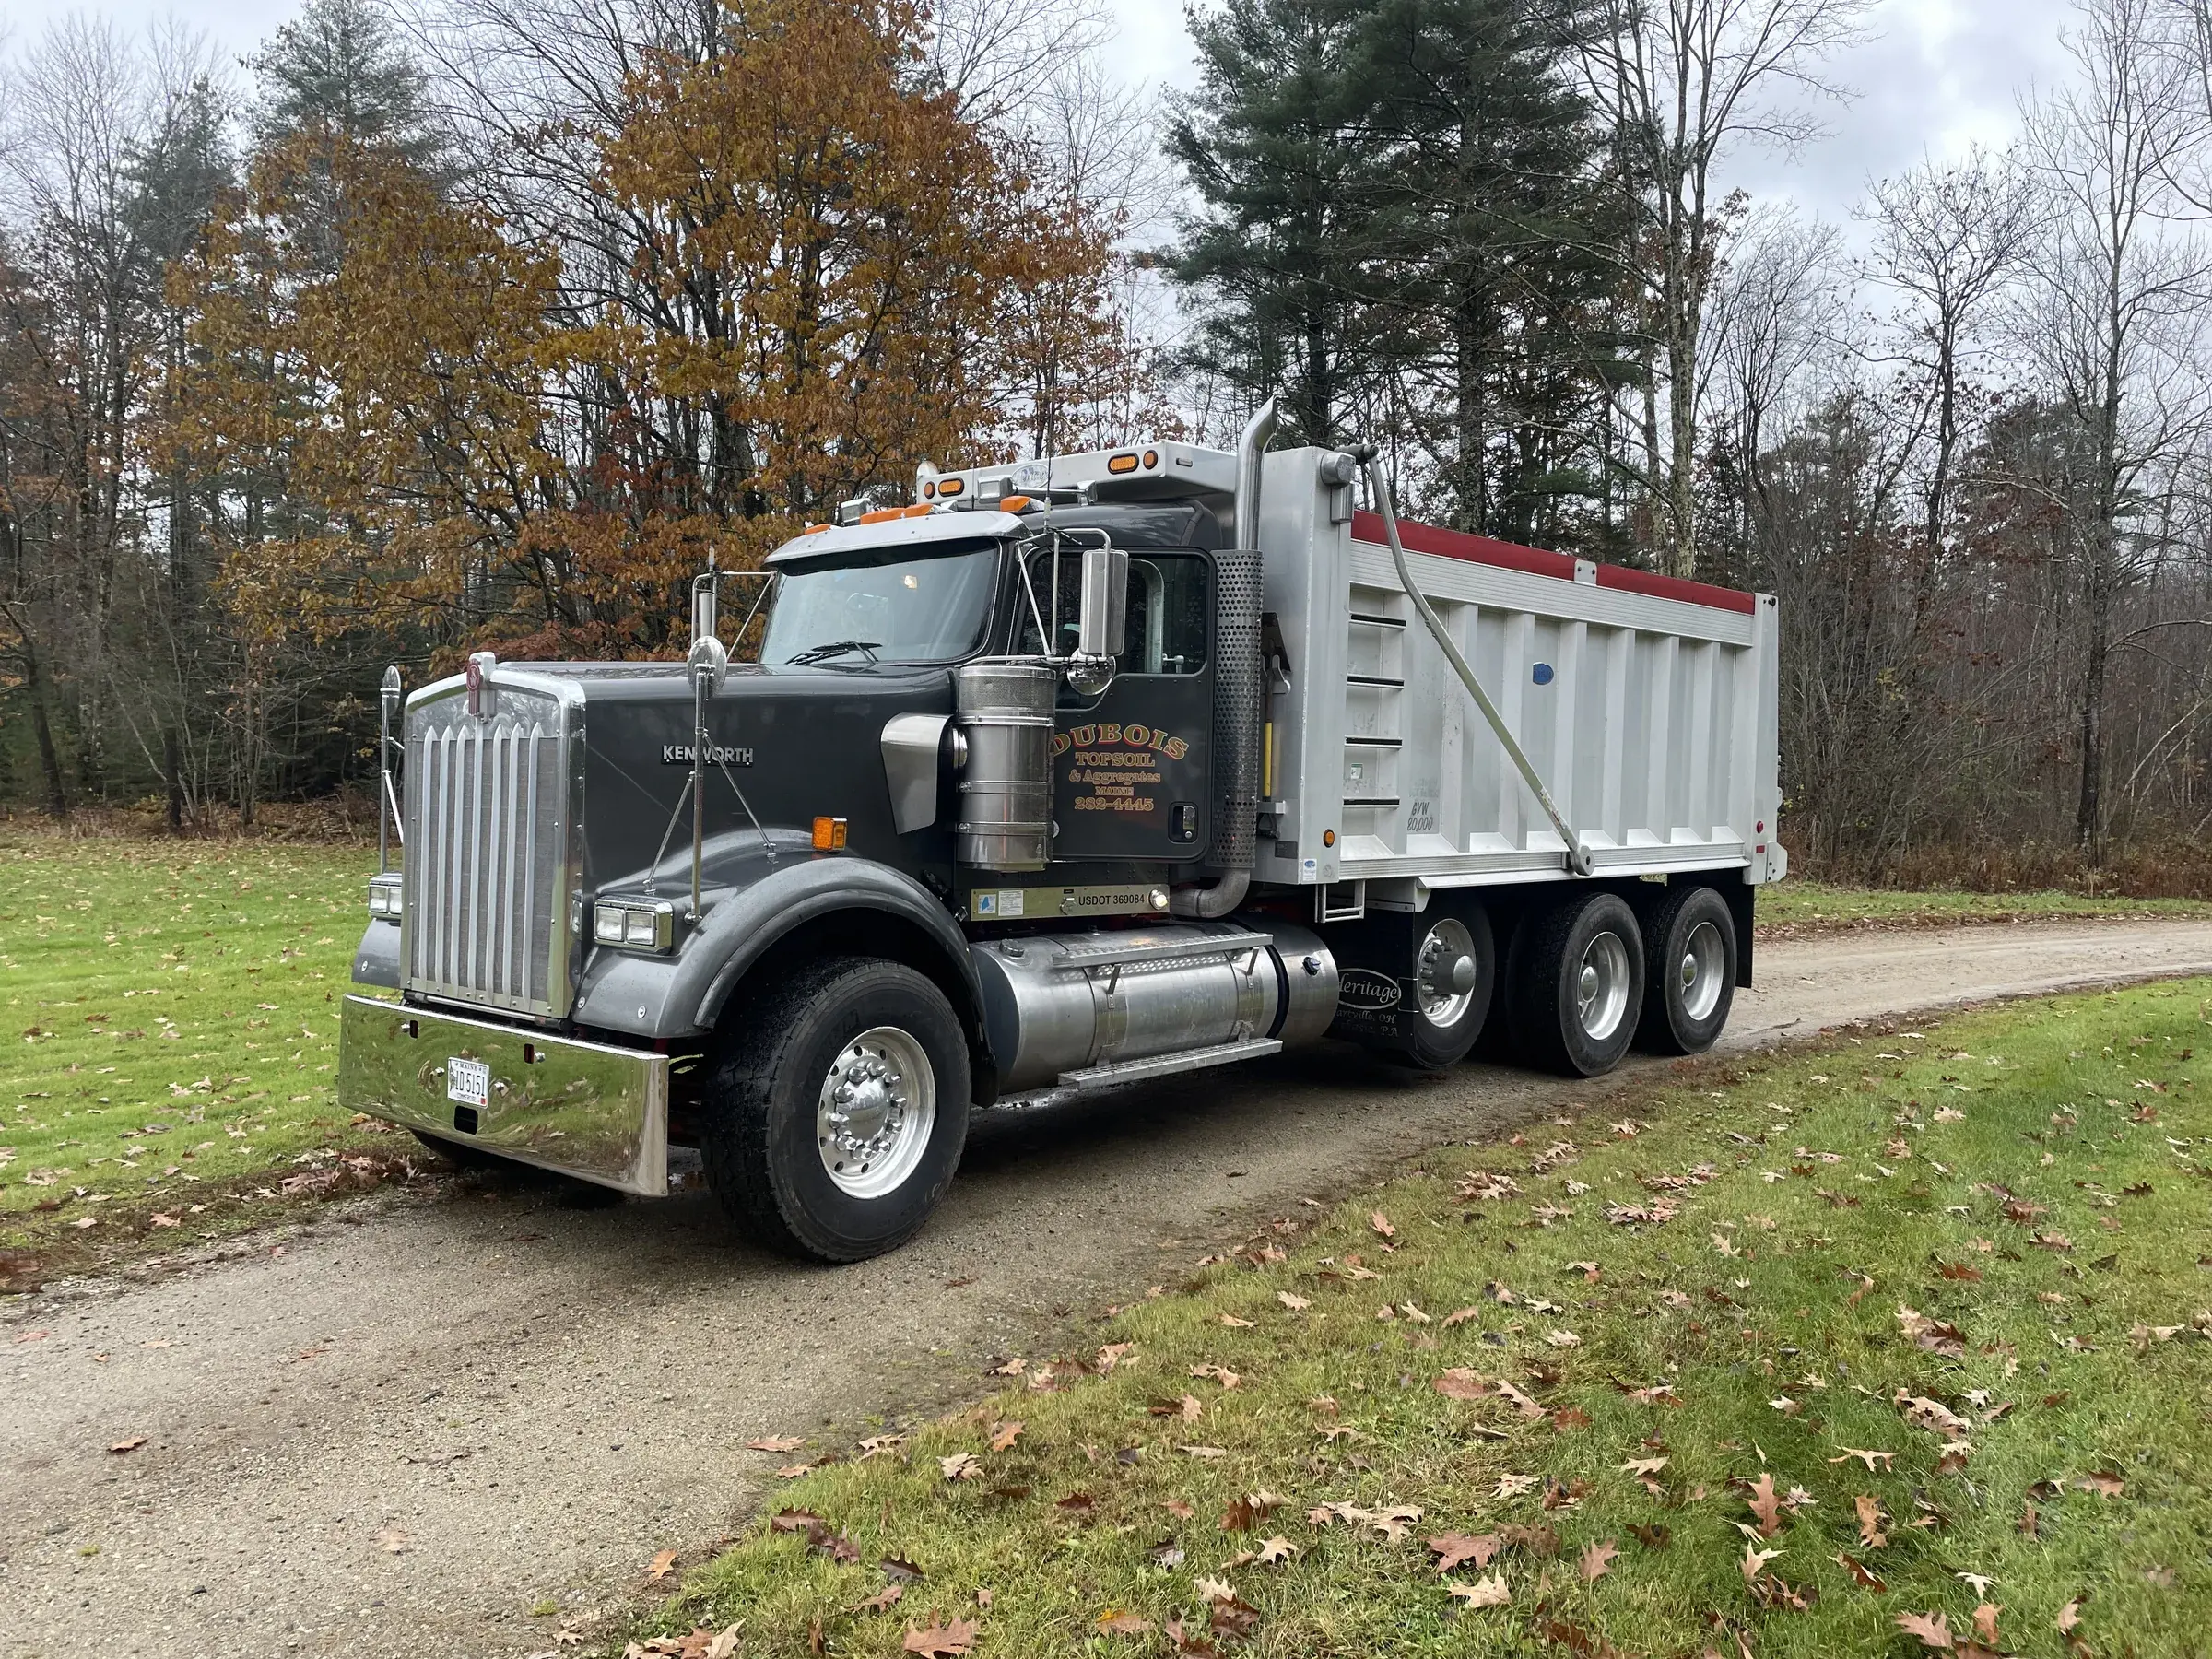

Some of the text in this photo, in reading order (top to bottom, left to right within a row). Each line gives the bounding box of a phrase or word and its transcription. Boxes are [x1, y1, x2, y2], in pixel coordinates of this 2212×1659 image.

[1054, 723, 1189, 760] DUBOIS
[663, 745, 754, 762] KENWORTH
[1075, 752, 1155, 767] TOPSOIL
[1068, 769, 1161, 785] & Aggregates
[1095, 786, 1134, 796] MAINE
[1074, 797, 1154, 811] 282-4445
[1411, 801, 1430, 816] GVW
[1406, 817, 1433, 831] 80,000
[1078, 894, 1145, 906] USDOT 369084
